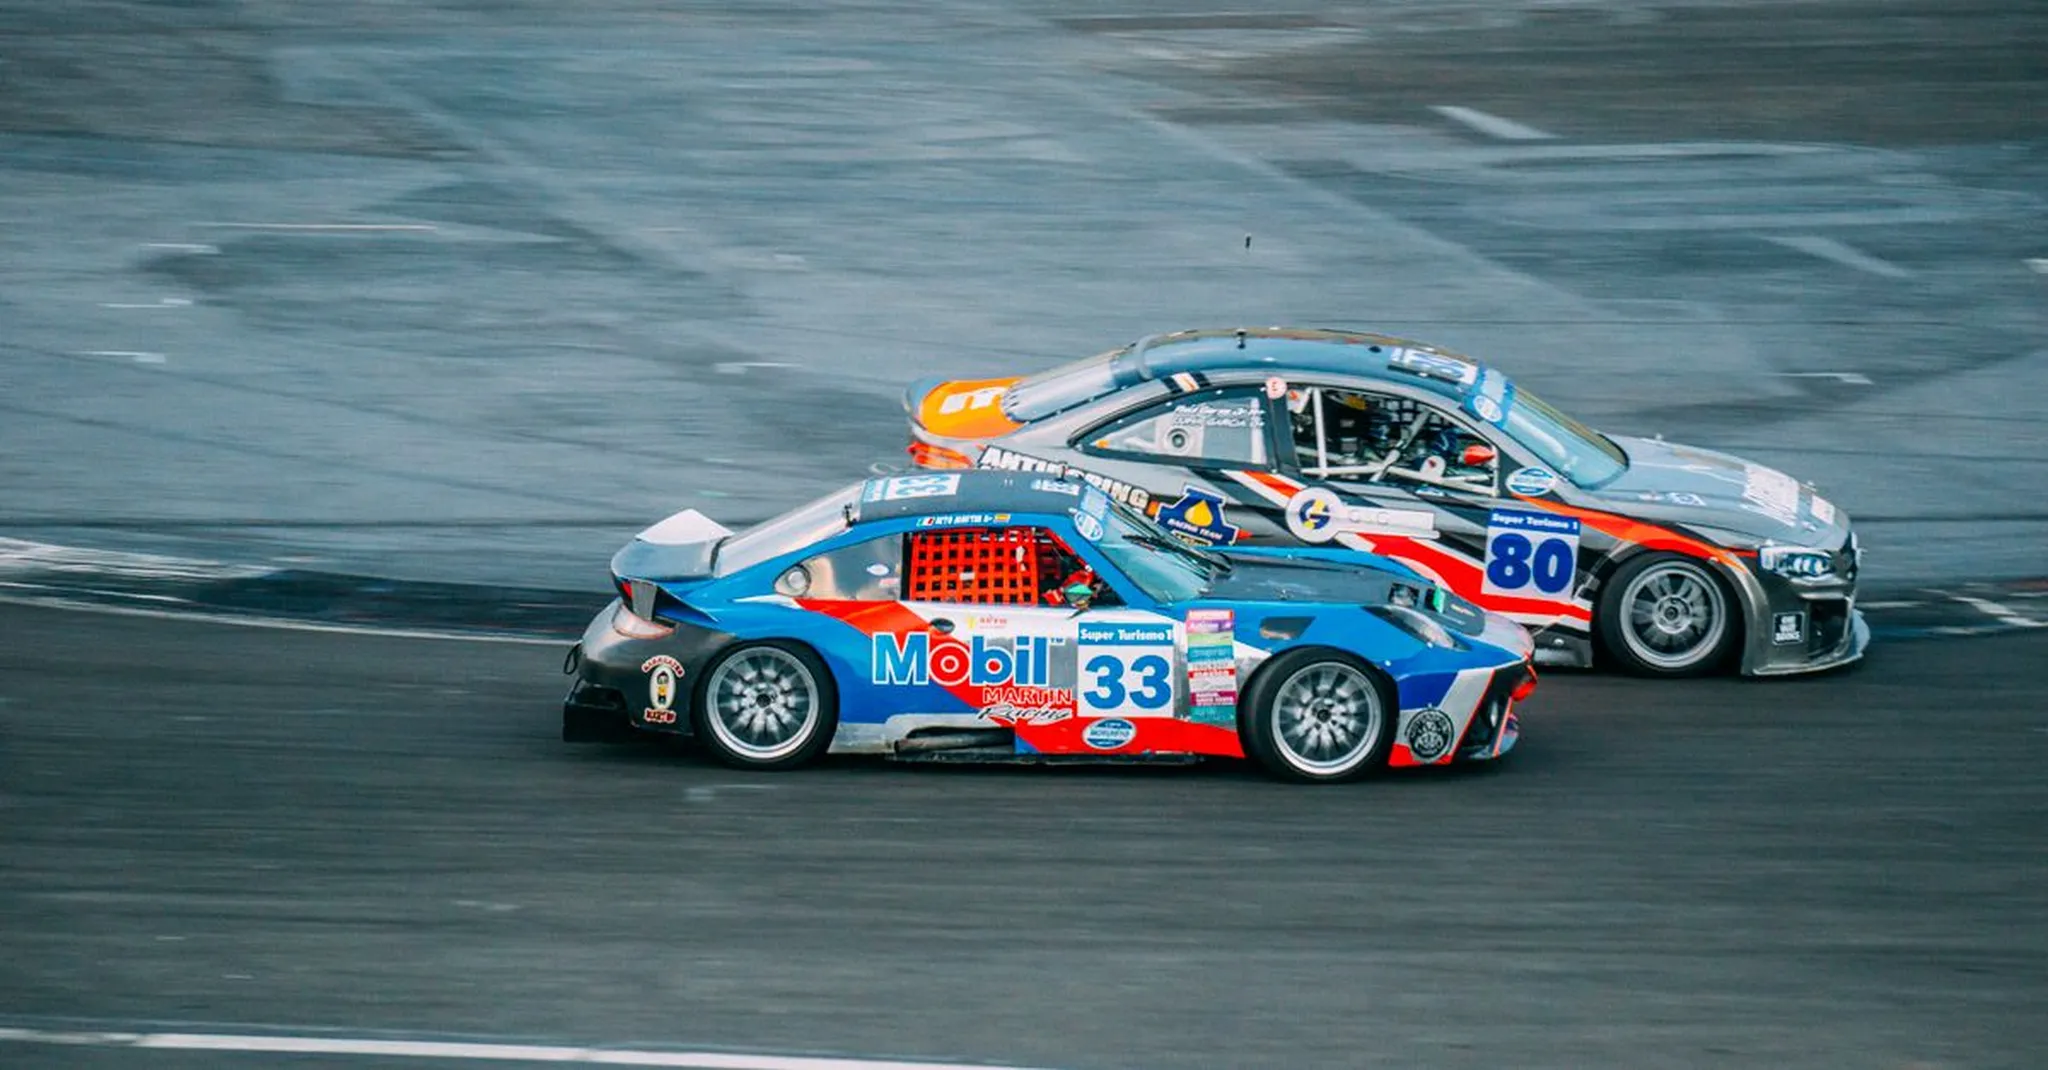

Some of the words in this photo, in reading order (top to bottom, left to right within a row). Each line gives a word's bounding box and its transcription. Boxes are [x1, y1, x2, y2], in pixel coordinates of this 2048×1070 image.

[1492, 512, 1524, 525] Super
[1526, 516, 1569, 529] Turismo
[1486, 532, 1574, 594] 80
[1080, 628, 1114, 642] Super
[1117, 629, 1165, 641] Turismo
[872, 631, 1050, 687] Mobil
[982, 687, 1073, 705] MARTIN
[1083, 654, 1172, 710] 33
